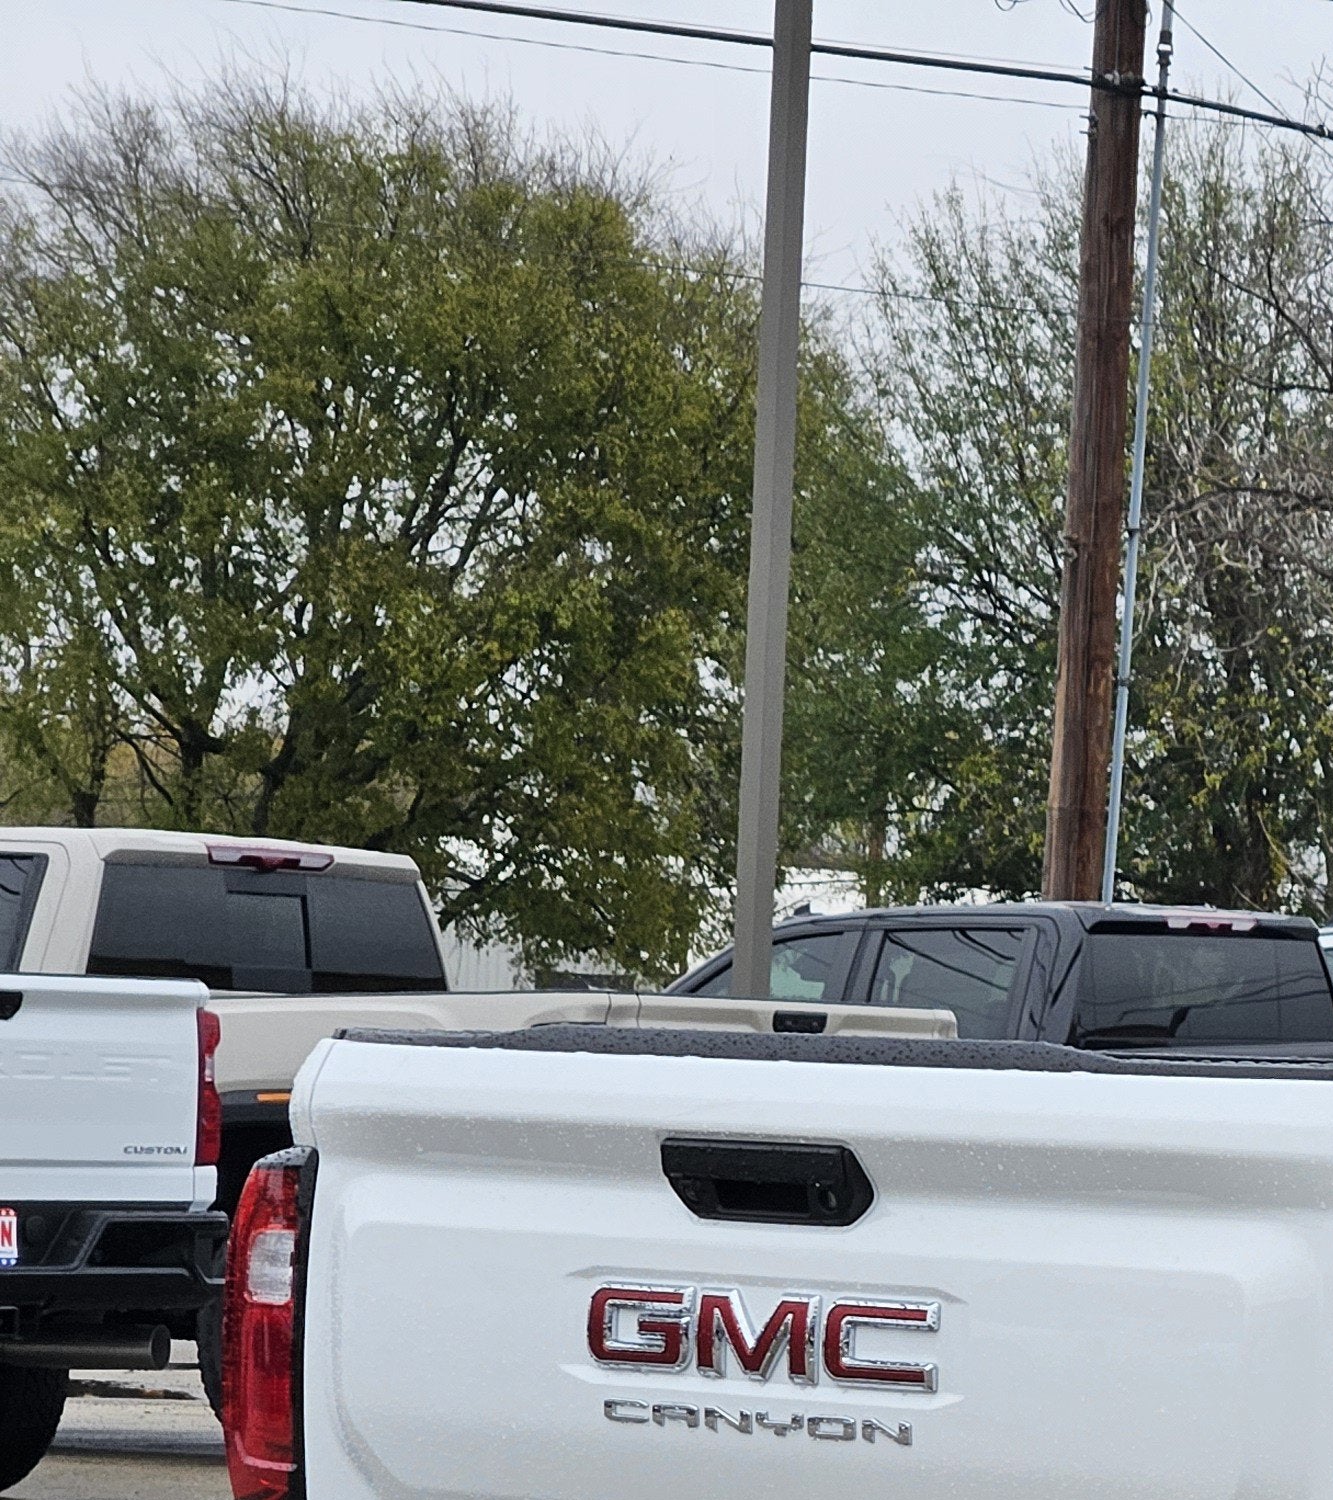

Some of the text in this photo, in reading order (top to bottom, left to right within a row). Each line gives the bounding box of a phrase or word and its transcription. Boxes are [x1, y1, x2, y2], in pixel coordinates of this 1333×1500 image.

[122, 1144, 189, 1156] CUSTOM
[587, 1280, 941, 1393] GMC
[603, 1398, 912, 1446] CANYON
